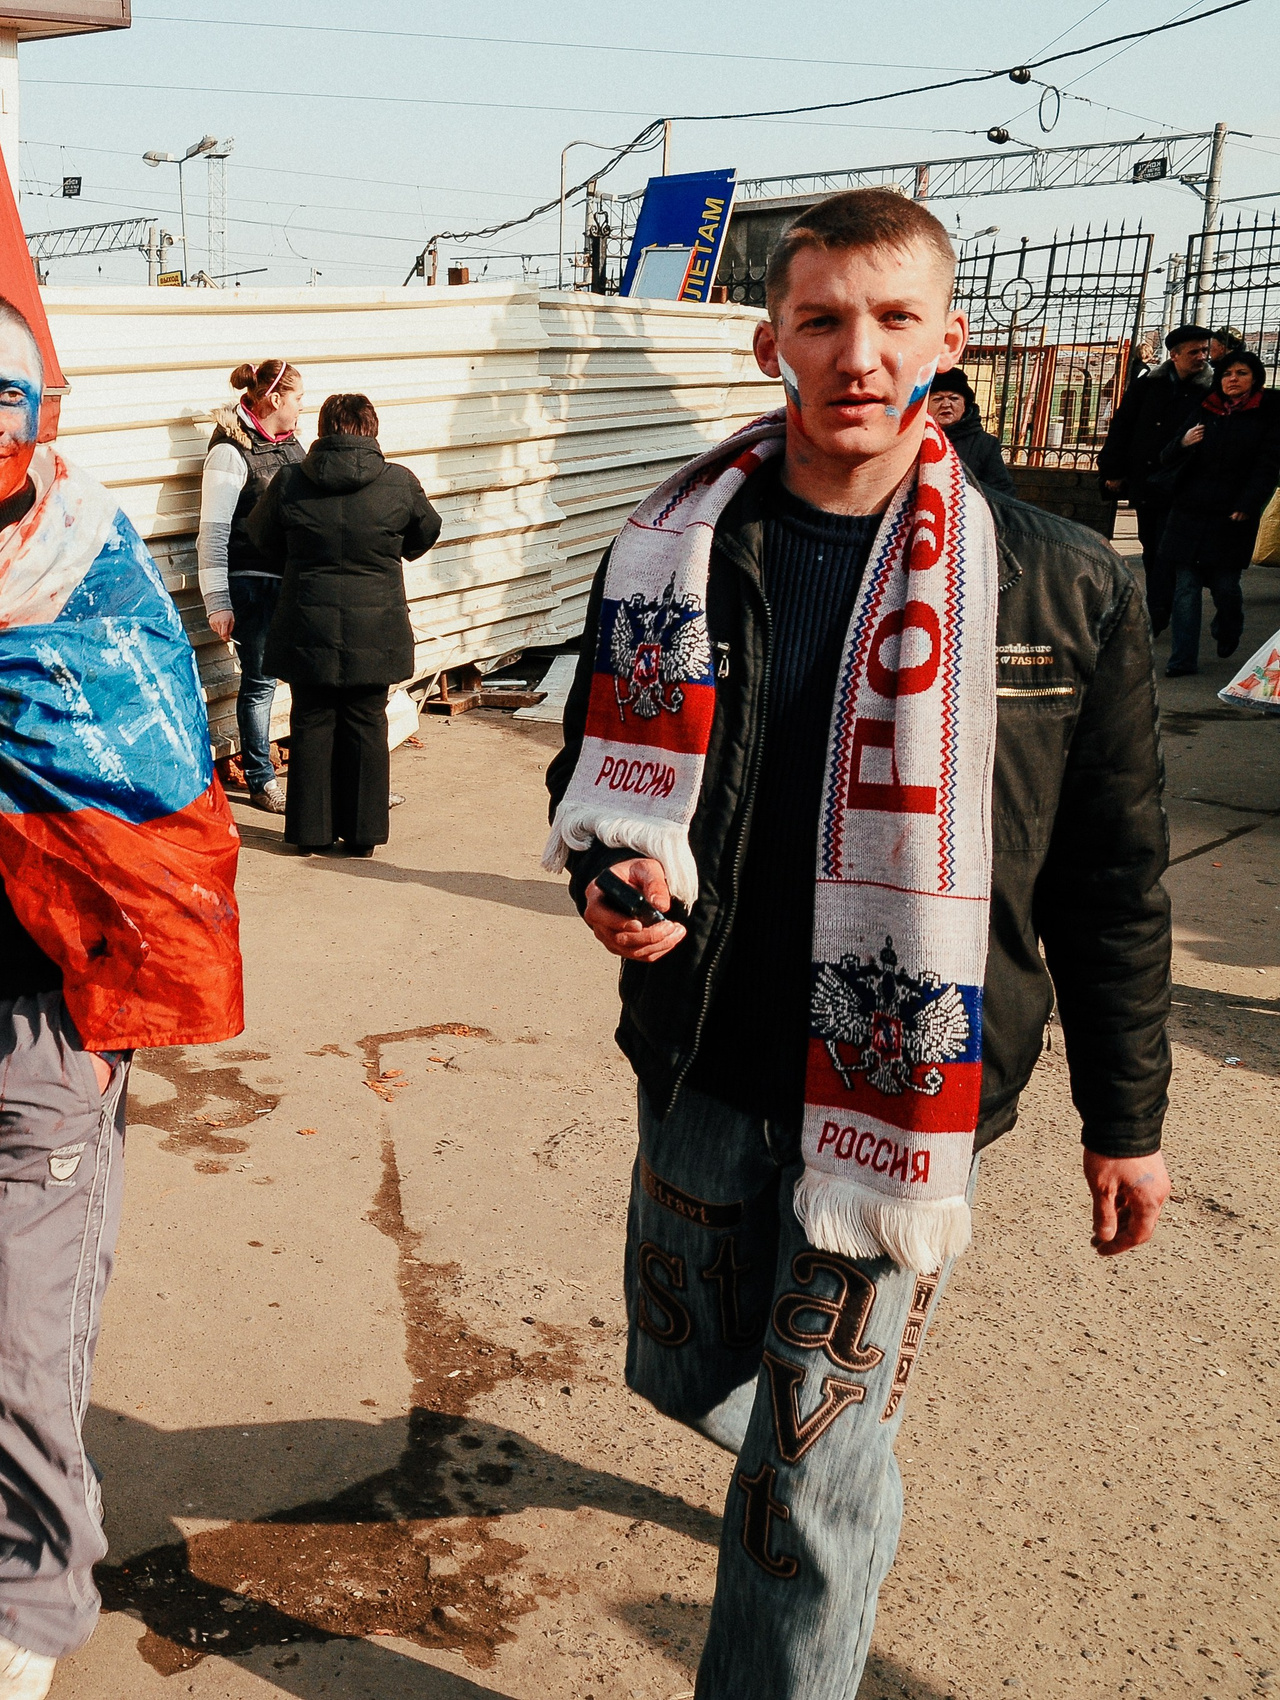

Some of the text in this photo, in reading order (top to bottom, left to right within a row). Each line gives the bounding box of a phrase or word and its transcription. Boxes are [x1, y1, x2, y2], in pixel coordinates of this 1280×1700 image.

[1011, 656, 1054, 665] FASION
[594, 755, 676, 798] РОССИЯ
[817, 1120, 931, 1183] РОССИЯ
